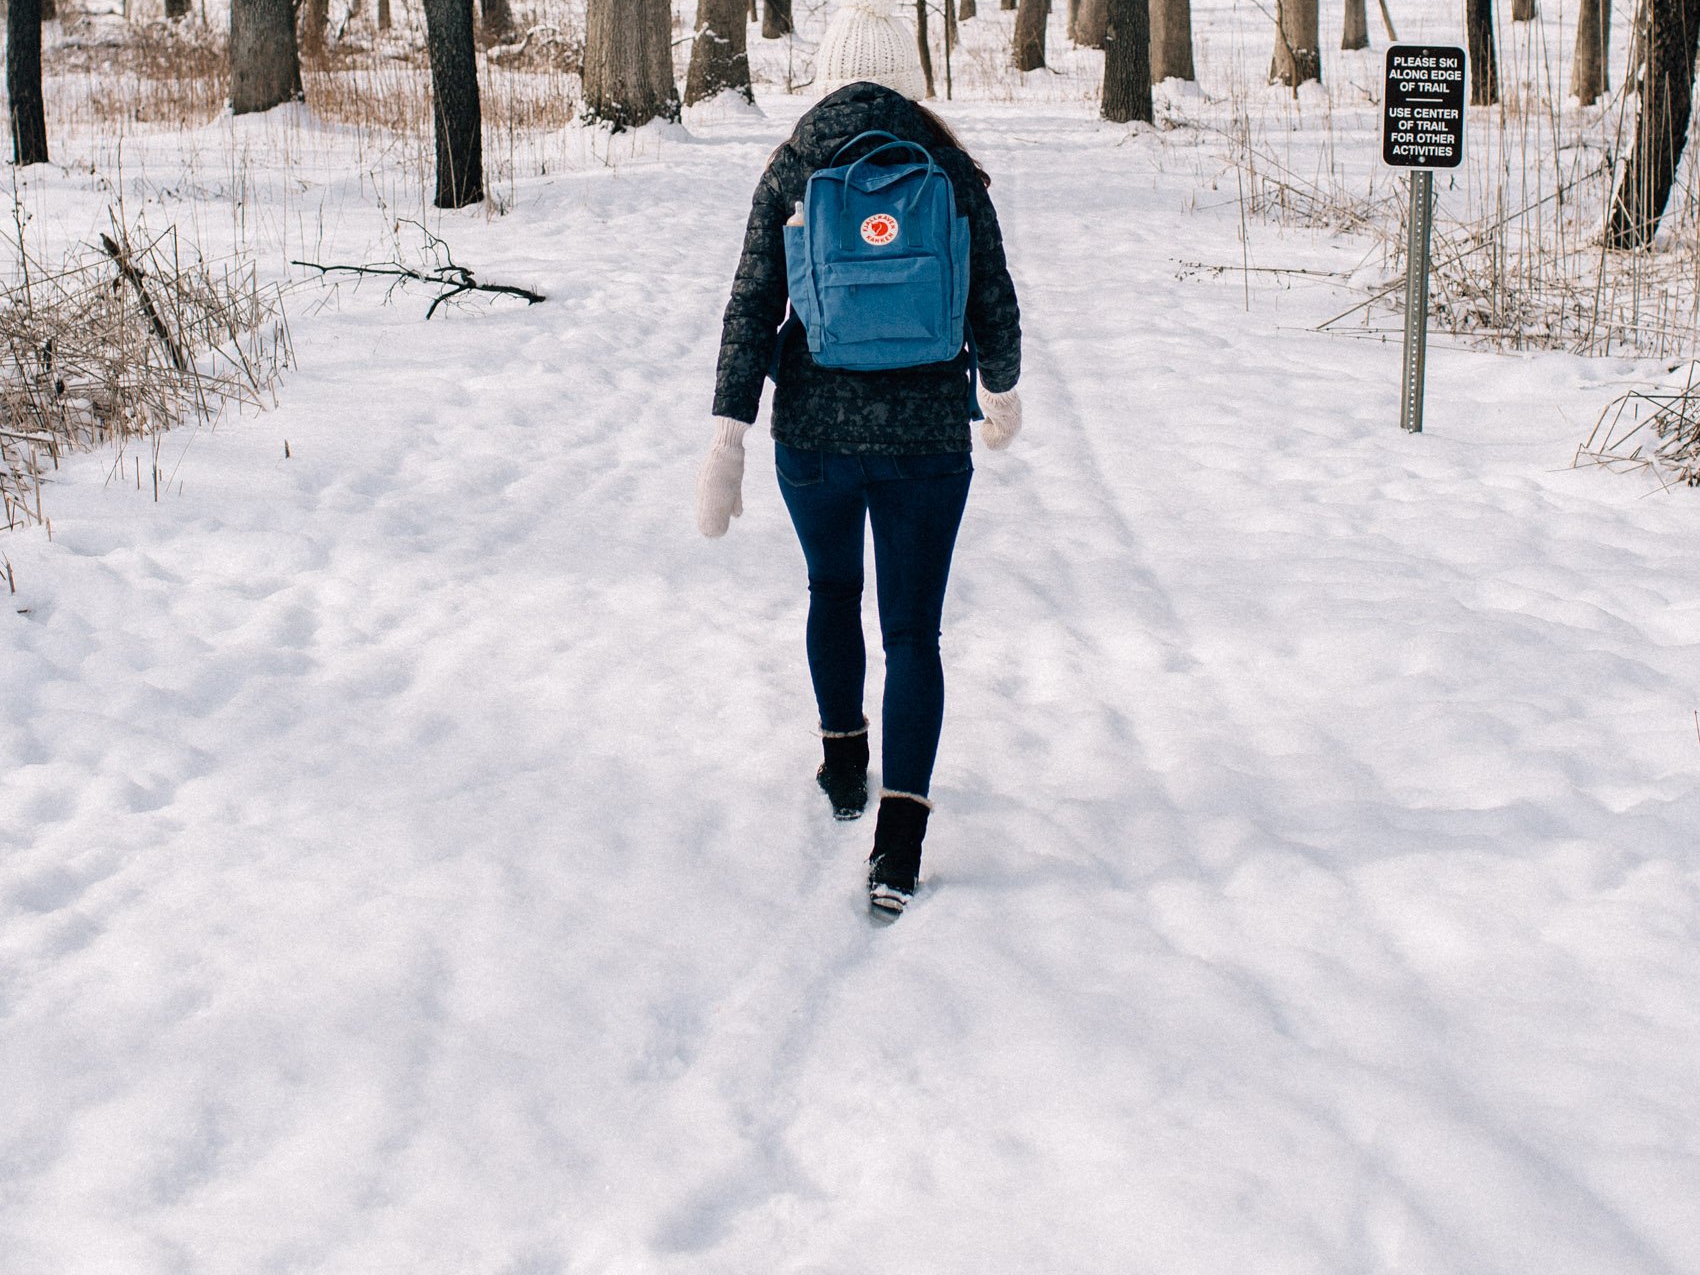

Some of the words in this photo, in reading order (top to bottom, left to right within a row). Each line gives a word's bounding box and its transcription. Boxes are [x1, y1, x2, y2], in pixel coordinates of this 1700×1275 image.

[1394, 57, 1437, 67] PLEASE
[1439, 58, 1458, 68] SKI
[1389, 69, 1428, 80] ALONG
[1431, 70, 1462, 81] EDGE
[1400, 82, 1416, 92] OF
[1418, 82, 1450, 93] TRAIL
[1389, 107, 1411, 118] USE
[1414, 108, 1459, 119] CENTER
[1398, 120, 1414, 130] OF
[1416, 121, 1448, 131] TRAIL
[1391, 132, 1414, 143] FOR
[1416, 133, 1455, 144] OTHER
[1392, 145, 1453, 157] ACTIVITIES
